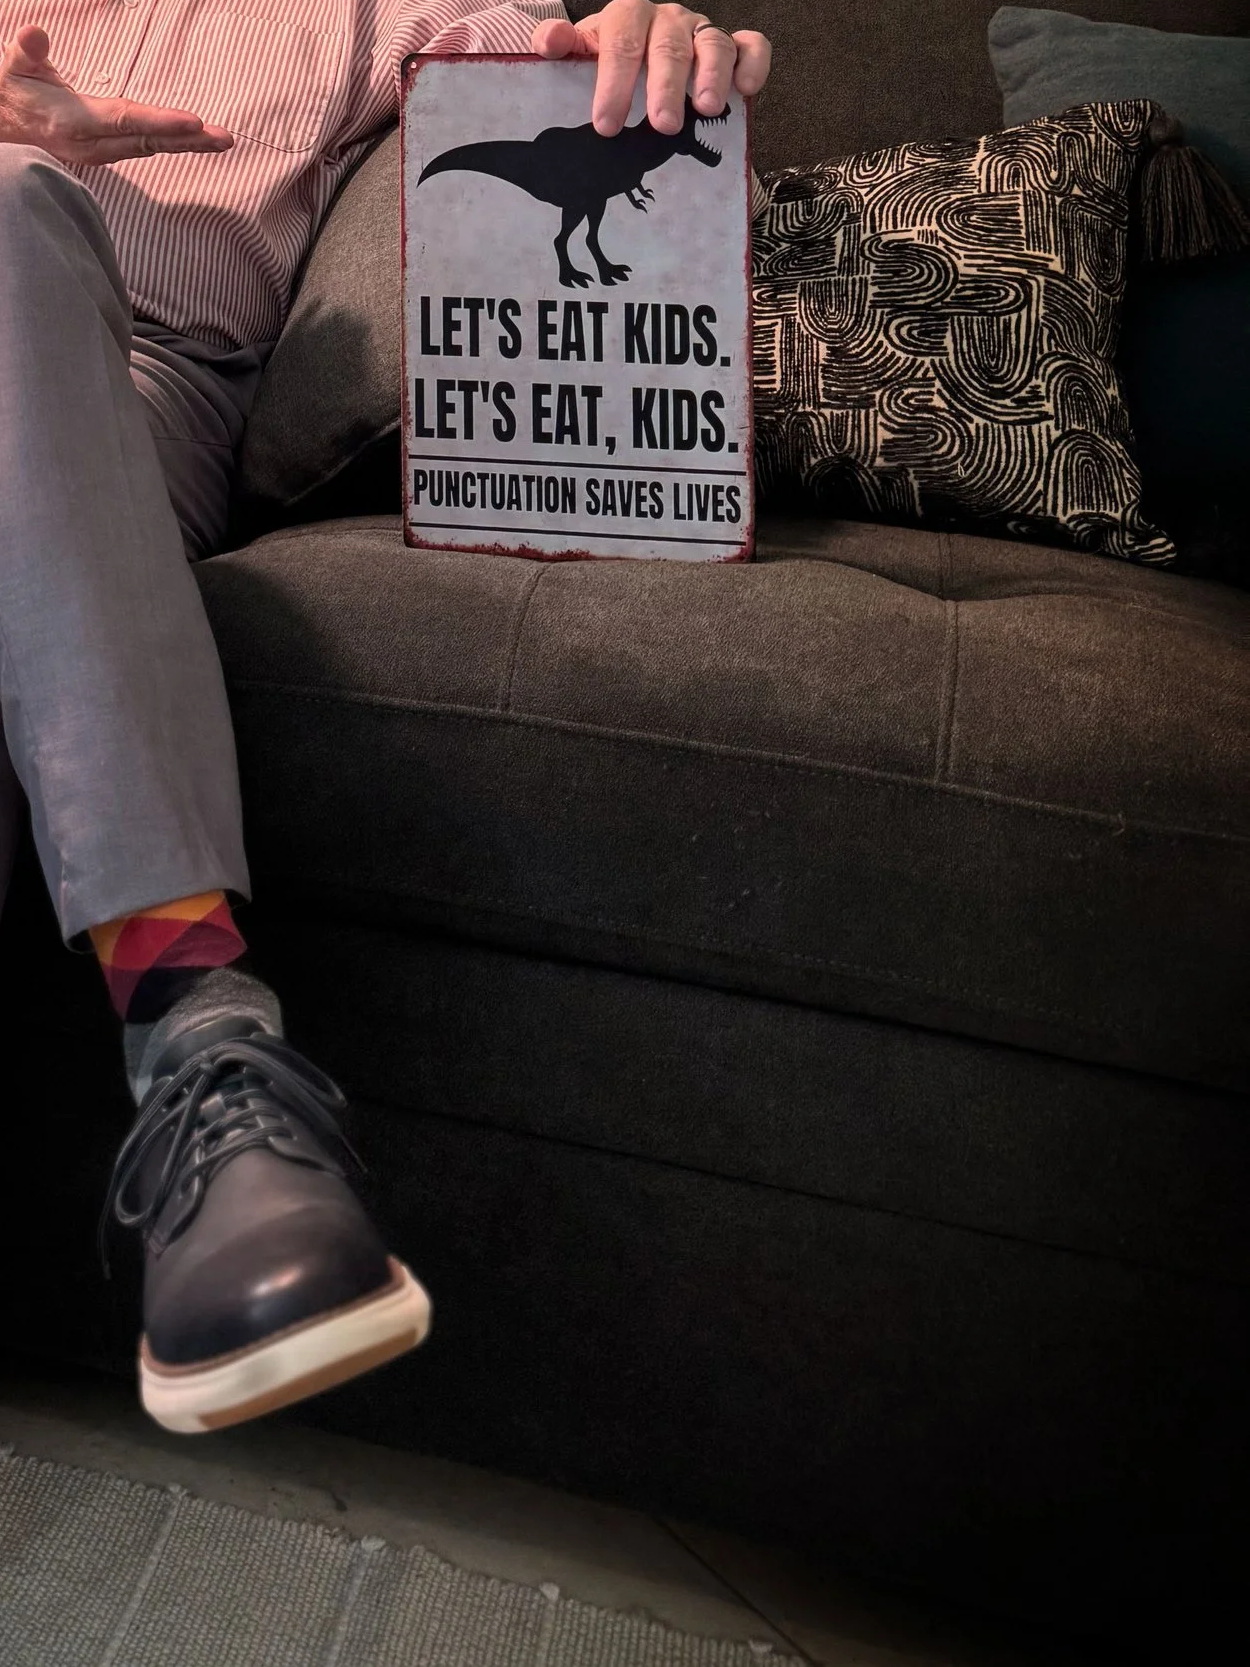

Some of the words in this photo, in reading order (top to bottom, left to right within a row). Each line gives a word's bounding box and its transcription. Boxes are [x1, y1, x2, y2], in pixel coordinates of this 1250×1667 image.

[420, 296, 522, 359] LET'S
[537, 300, 609, 362] EAT
[624, 302, 731, 367] KIDS.
[414, 377, 517, 443] LET'S
[532, 383, 617, 455] EAT,
[632, 387, 739, 453] KIDS.
[413, 469, 576, 514] PUNCTUATION
[586, 478, 664, 519] SAVES
[673, 483, 741, 524] LIVES
